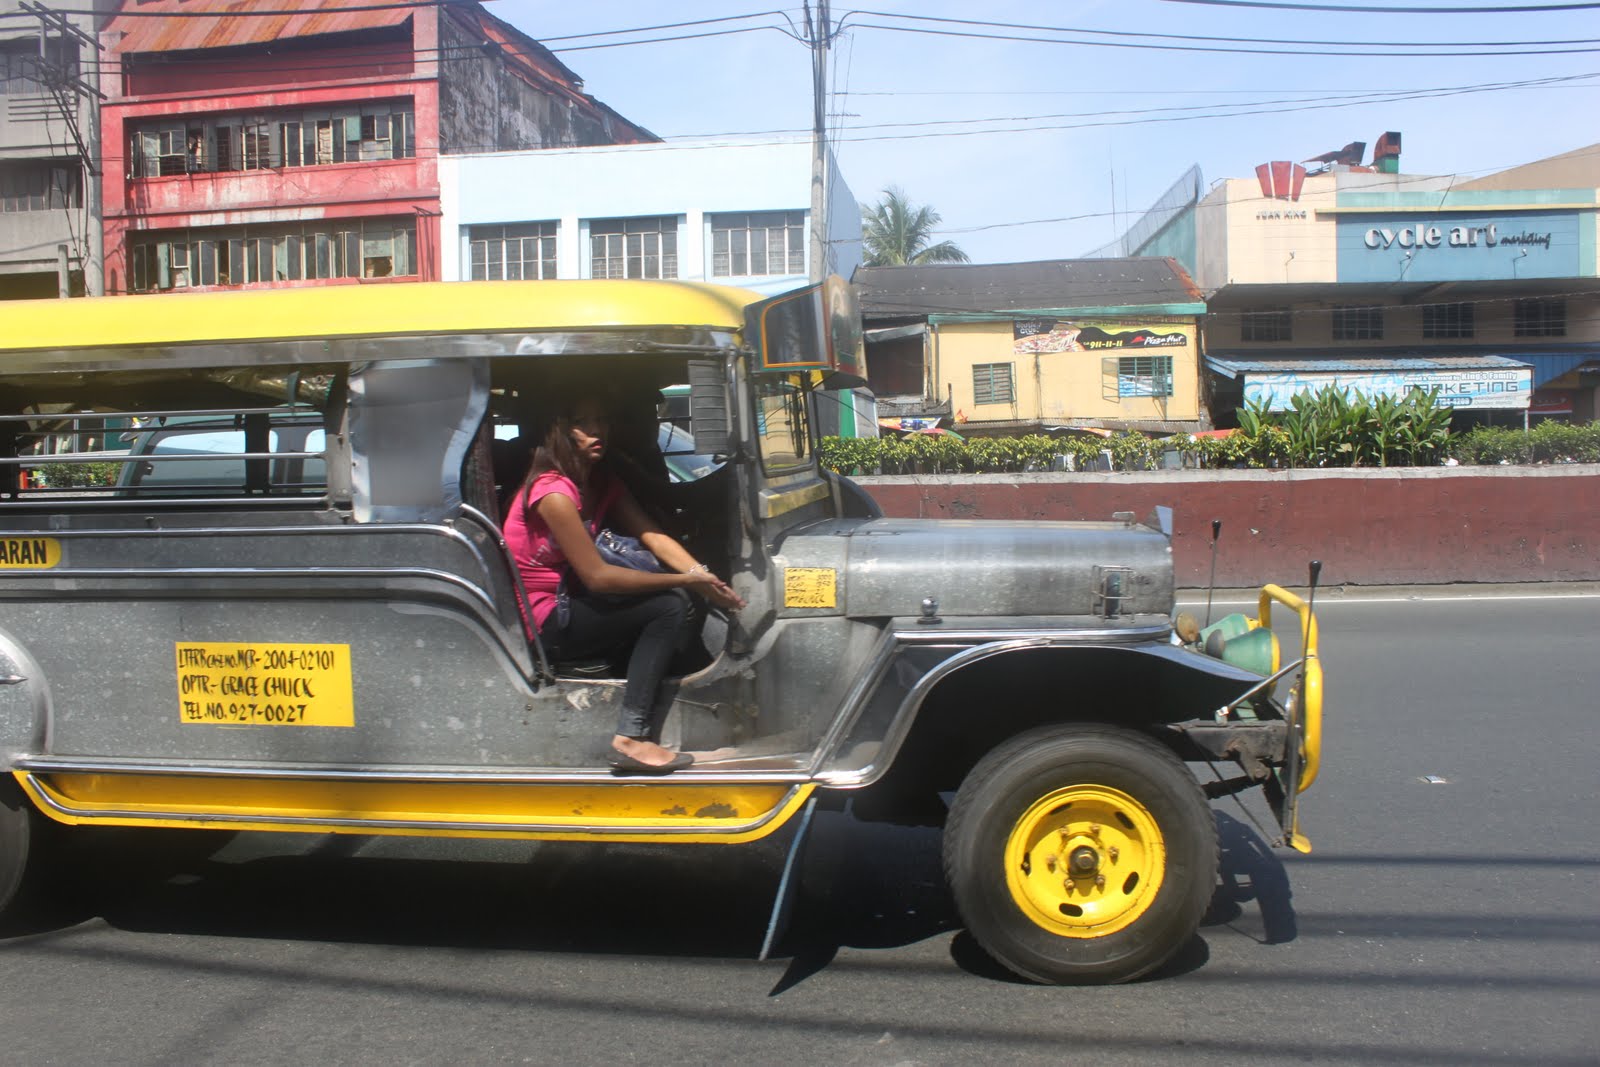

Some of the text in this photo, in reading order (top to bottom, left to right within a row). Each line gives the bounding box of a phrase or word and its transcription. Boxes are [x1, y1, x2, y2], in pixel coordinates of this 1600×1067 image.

[1364, 223, 1441, 250] cycle
[1448, 223, 1497, 249] art
[1089, 341, 1123, 349] 911-11-11
[1144, 335, 1185, 346] Pizza Hut
[1461, 371, 1488, 381] King's
[1489, 371, 1517, 380] Family
[0, 540, 47, 564] ARAN
[220, 675, 259, 697] GRACE
[263, 676, 315, 698] CHUCK
[229, 703, 308, 723] 927-0027
